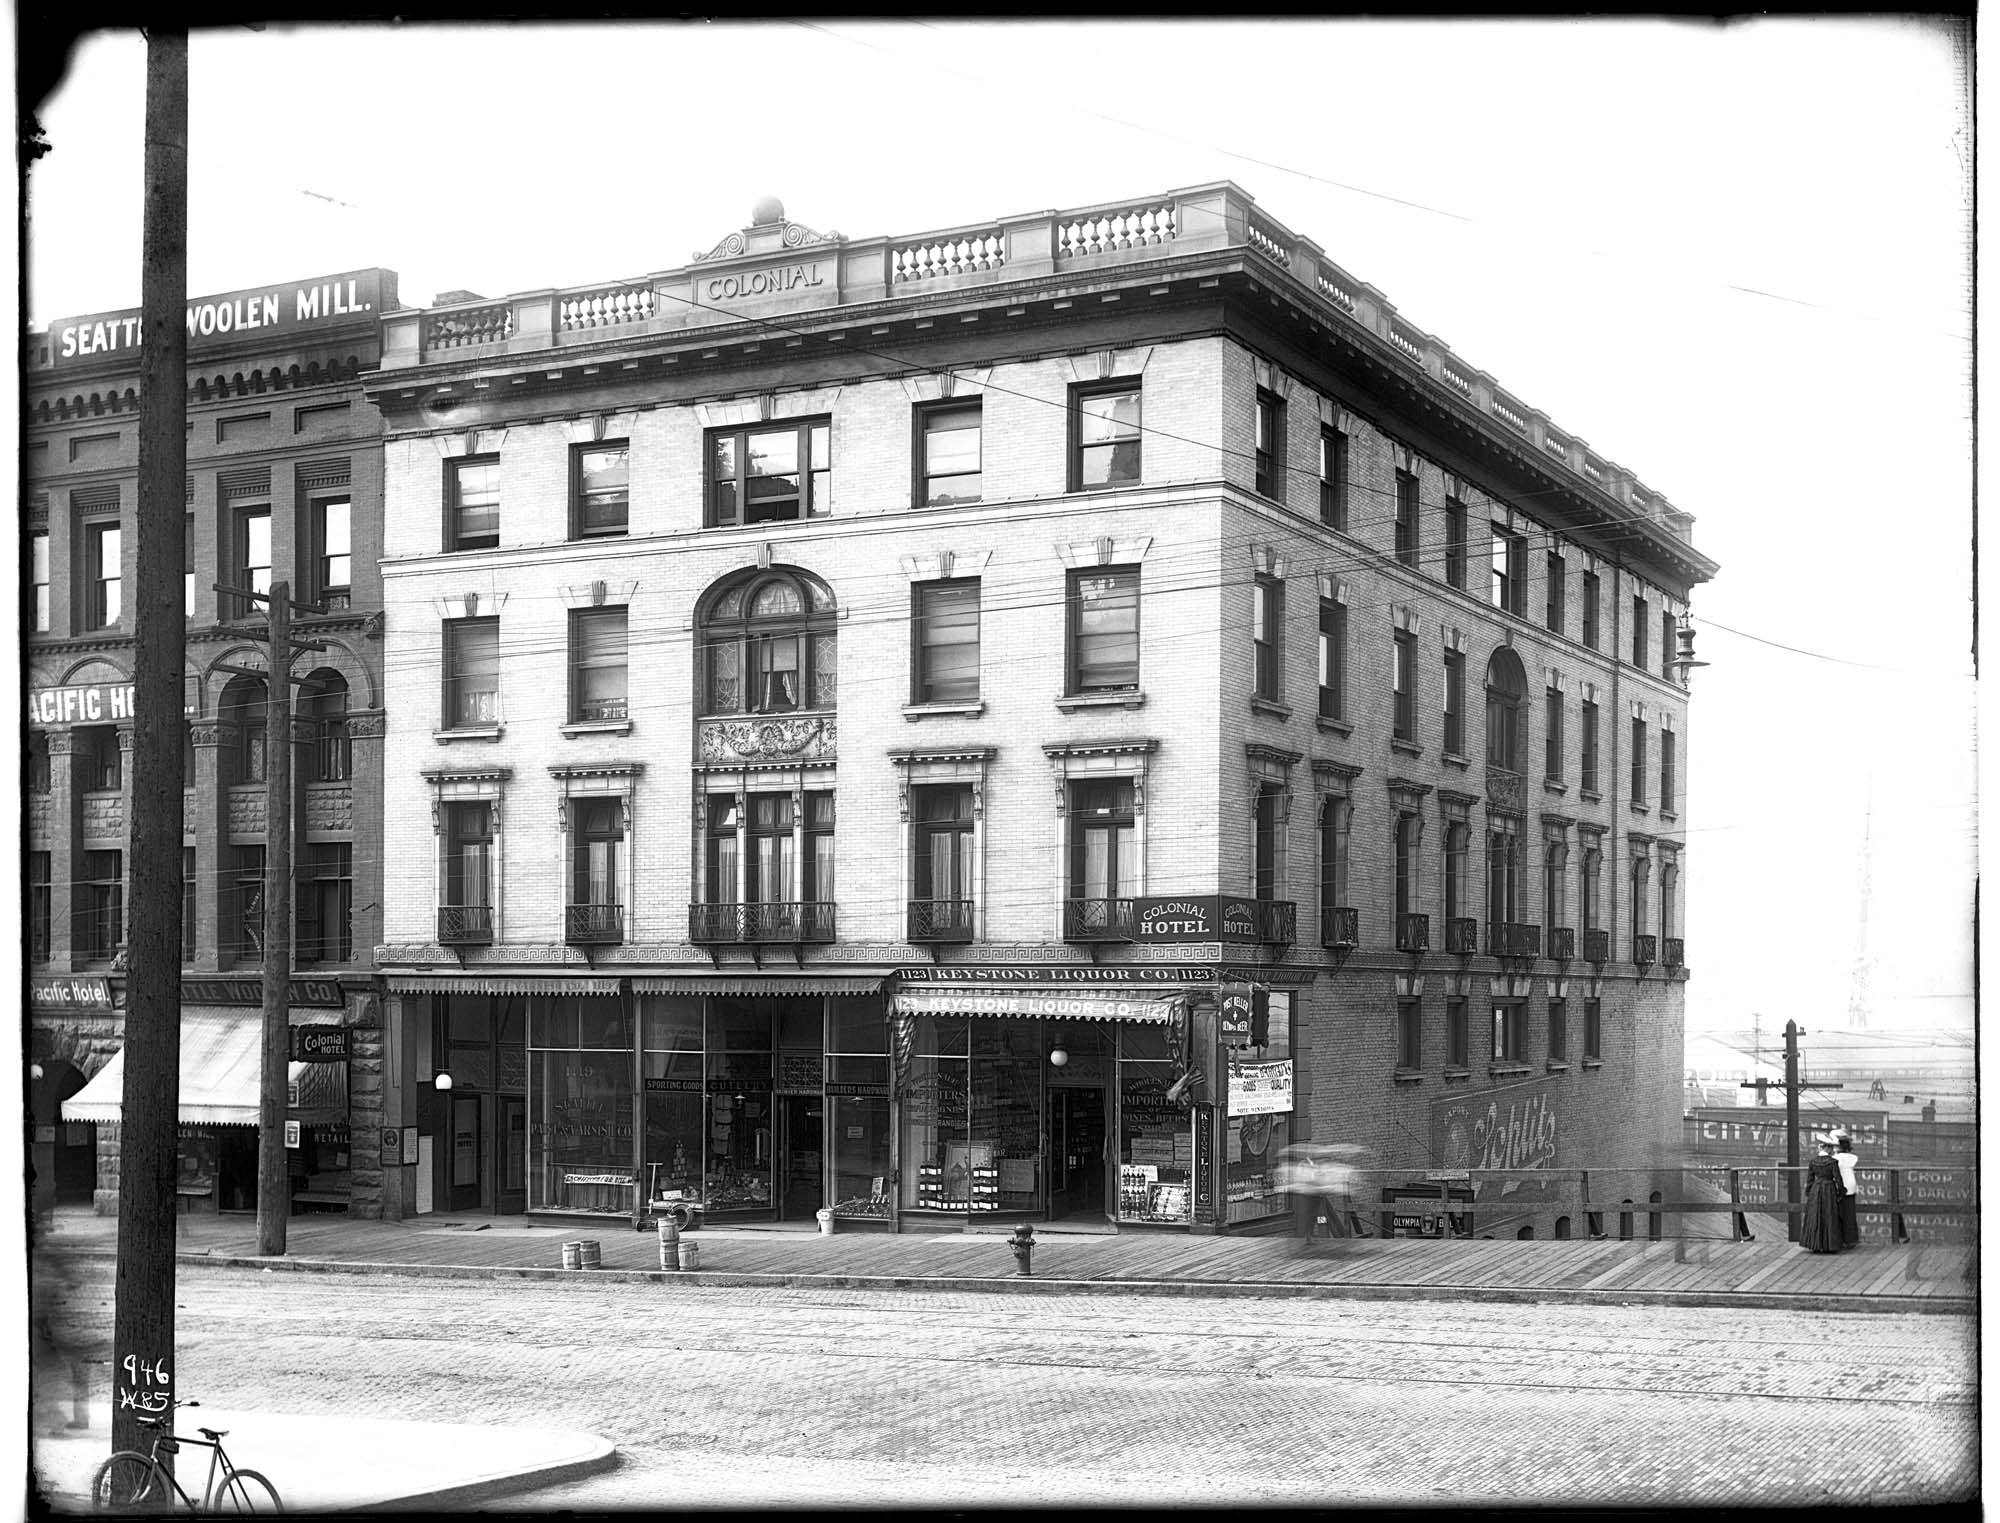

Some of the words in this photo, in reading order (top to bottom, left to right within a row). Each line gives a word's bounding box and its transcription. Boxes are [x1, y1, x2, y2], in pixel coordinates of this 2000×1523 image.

[708, 264, 823, 300] COLONIAL
[62, 316, 143, 358] SEATT
[297, 279, 371, 321] MILL.
[30, 688, 101, 723] ACIFIC
[1143, 902, 1207, 920] COLONIAL
[1224, 903, 1254, 920] COLONIAL
[1140, 920, 1210, 935] HOTEL
[1223, 920, 1257, 936] HOTEL
[901, 969, 927, 980] 1123
[936, 969, 1040, 980] KEYSTONE
[1050, 969, 1131, 982] LIQUOR
[1140, 969, 1176, 980] CO.
[1181, 969, 1210, 980] 1123
[929, 998, 1019, 1011] KEYSTONE
[1028, 1000, 1095, 1014] LIQUOR
[304, 1033, 345, 1051] Colonial
[321, 1045, 345, 1054] HOTEL
[647, 1080, 681, 1090] SPORTING
[1472, 1093, 1556, 1172] Schlitz
[1703, 1121, 1764, 1141] CITY
[1393, 1217, 1421, 1228] OLYMPIA
